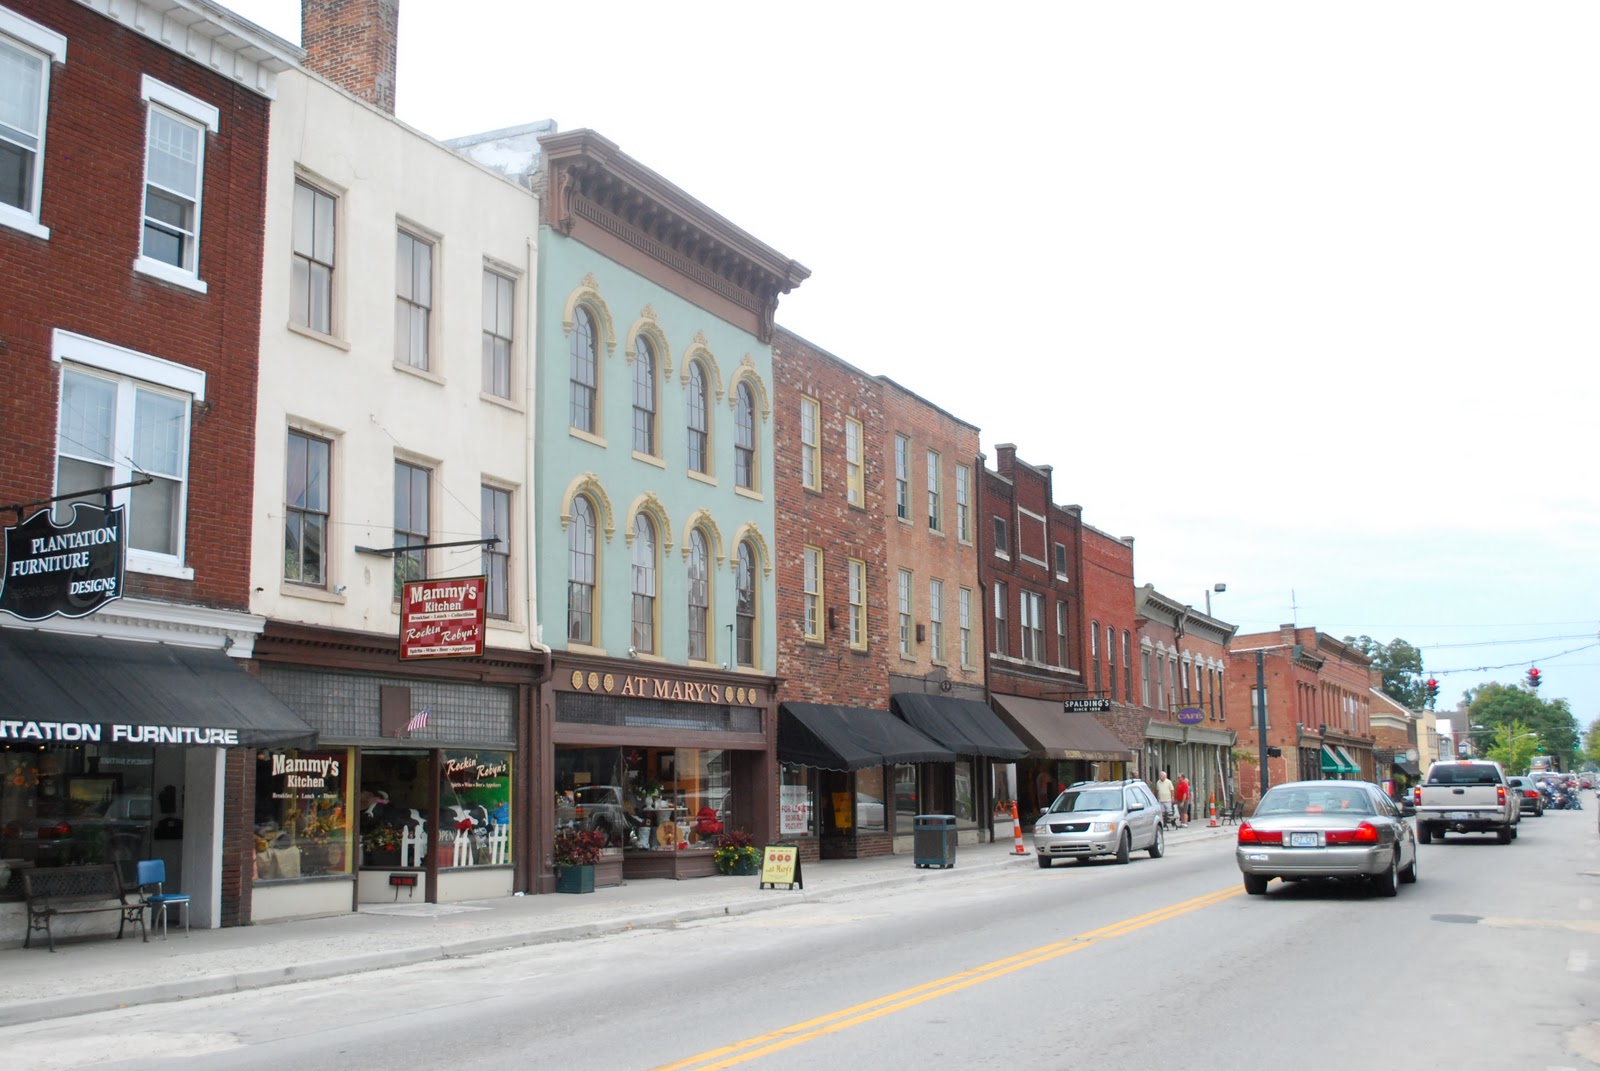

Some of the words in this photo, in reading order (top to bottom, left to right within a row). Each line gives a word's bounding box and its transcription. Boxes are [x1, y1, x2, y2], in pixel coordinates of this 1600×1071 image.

[32, 526, 117, 554] PLANTATION
[11, 551, 90, 577] FURNITURE
[70, 577, 116, 595] DESIGNS
[411, 584, 476, 604] Mammy's
[425, 601, 461, 612] Kitchen
[406, 622, 442, 642] Rockin'
[441, 625, 478, 644] Robyn's
[621, 675, 649, 697] AT
[652, 678, 719, 703] MARY'S
[1064, 699, 1110, 708] SPALDING'S
[0, 720, 101, 742] TATION
[112, 724, 239, 745] FURNITURE
[272, 755, 339, 777] Mammy's
[447, 754, 478, 775] Rockin'
[477, 761, 506, 780] Robyn's
[288, 775, 325, 787] Kitchen
